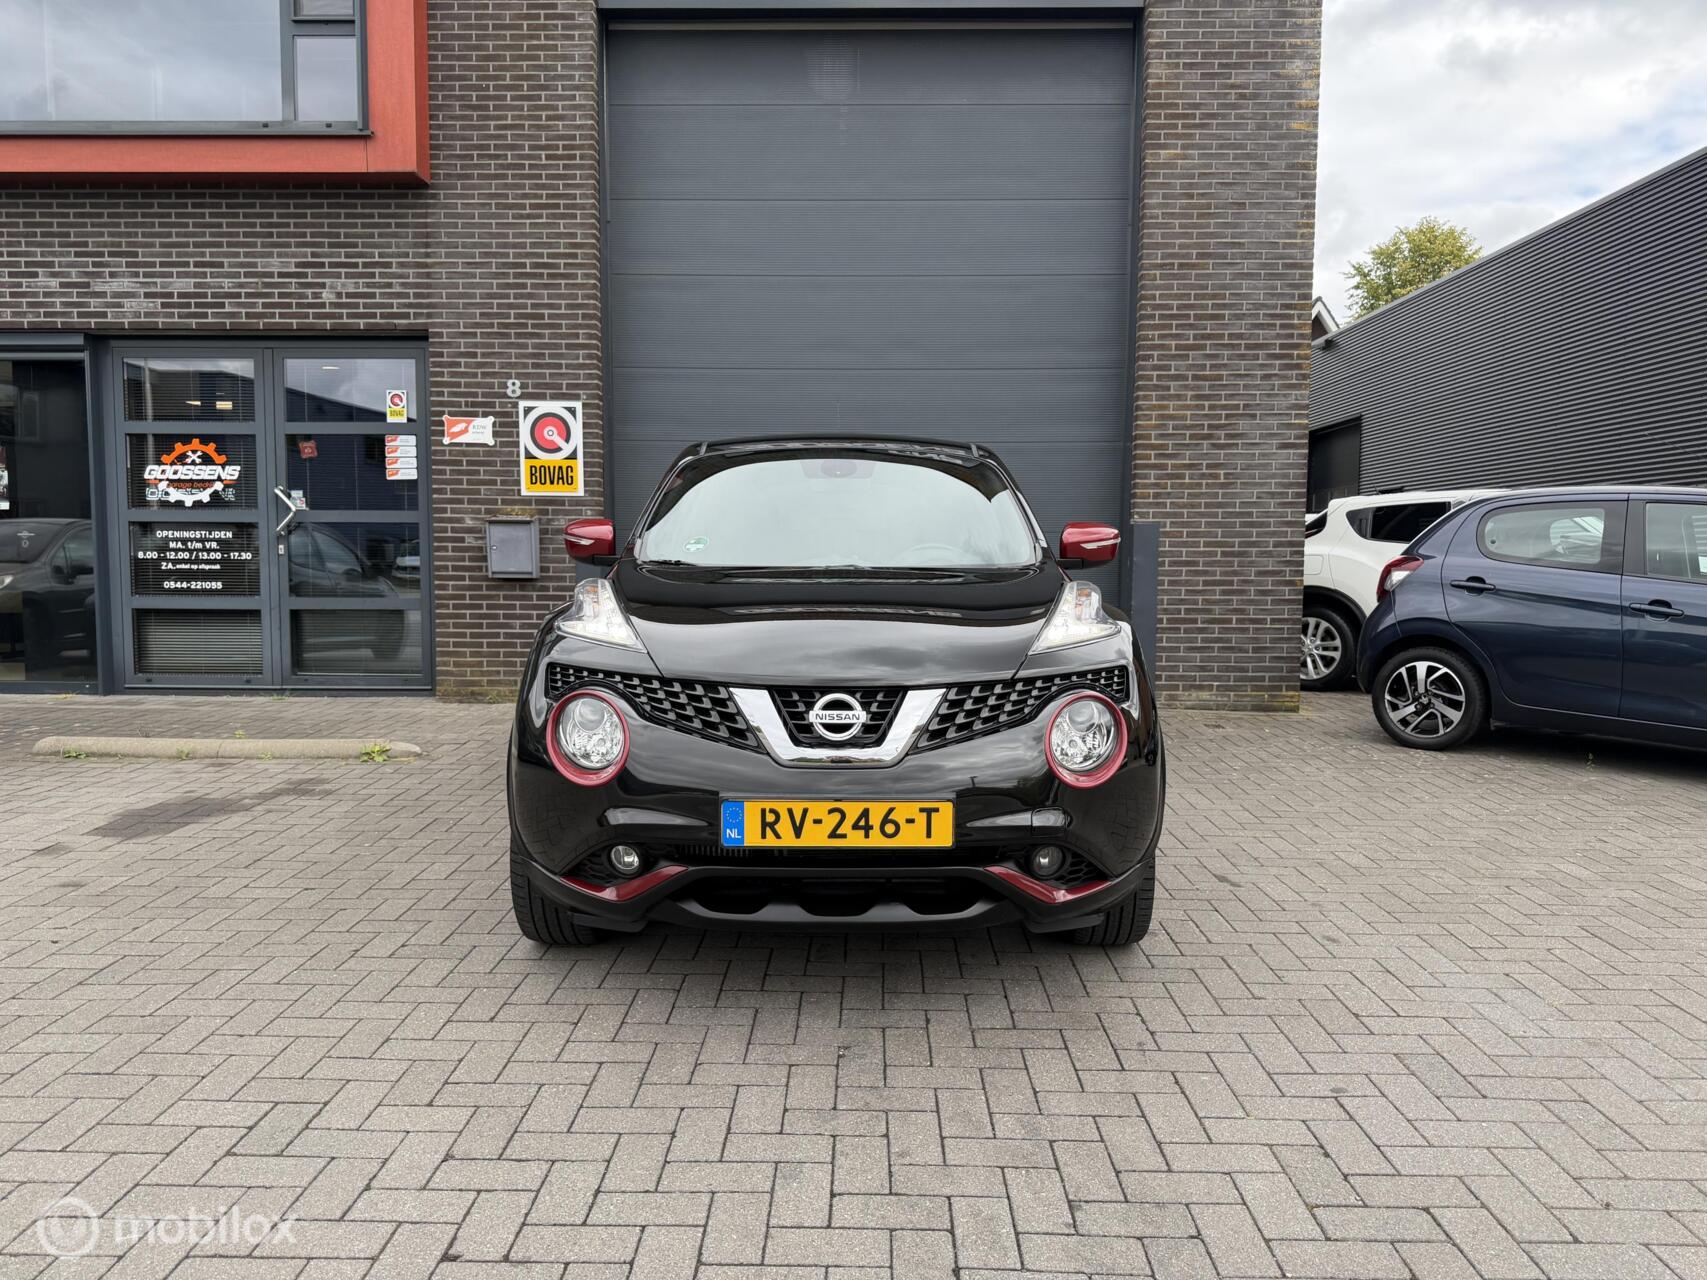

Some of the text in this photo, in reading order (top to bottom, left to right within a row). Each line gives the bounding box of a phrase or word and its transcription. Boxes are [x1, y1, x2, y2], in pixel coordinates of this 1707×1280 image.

[506, 379, 522, 398] 8
[144, 465, 241, 480] GOOSSENS
[529, 465, 574, 486] BOVAG
[156, 530, 233, 539] OPENINGSTIJDEN
[169, 541, 220, 549] MA. t/m VR.
[138, 551, 158, 559] 8.00
[166, 551, 190, 559] 12.00
[199, 552, 221, 560] 13.00
[230, 552, 252, 560] 17.30
[163, 581, 223, 589] 0544-221055
[814, 712, 861, 721] NISSAN
[759, 806, 940, 840] RV-246-T
[726, 829, 741, 838] NL
